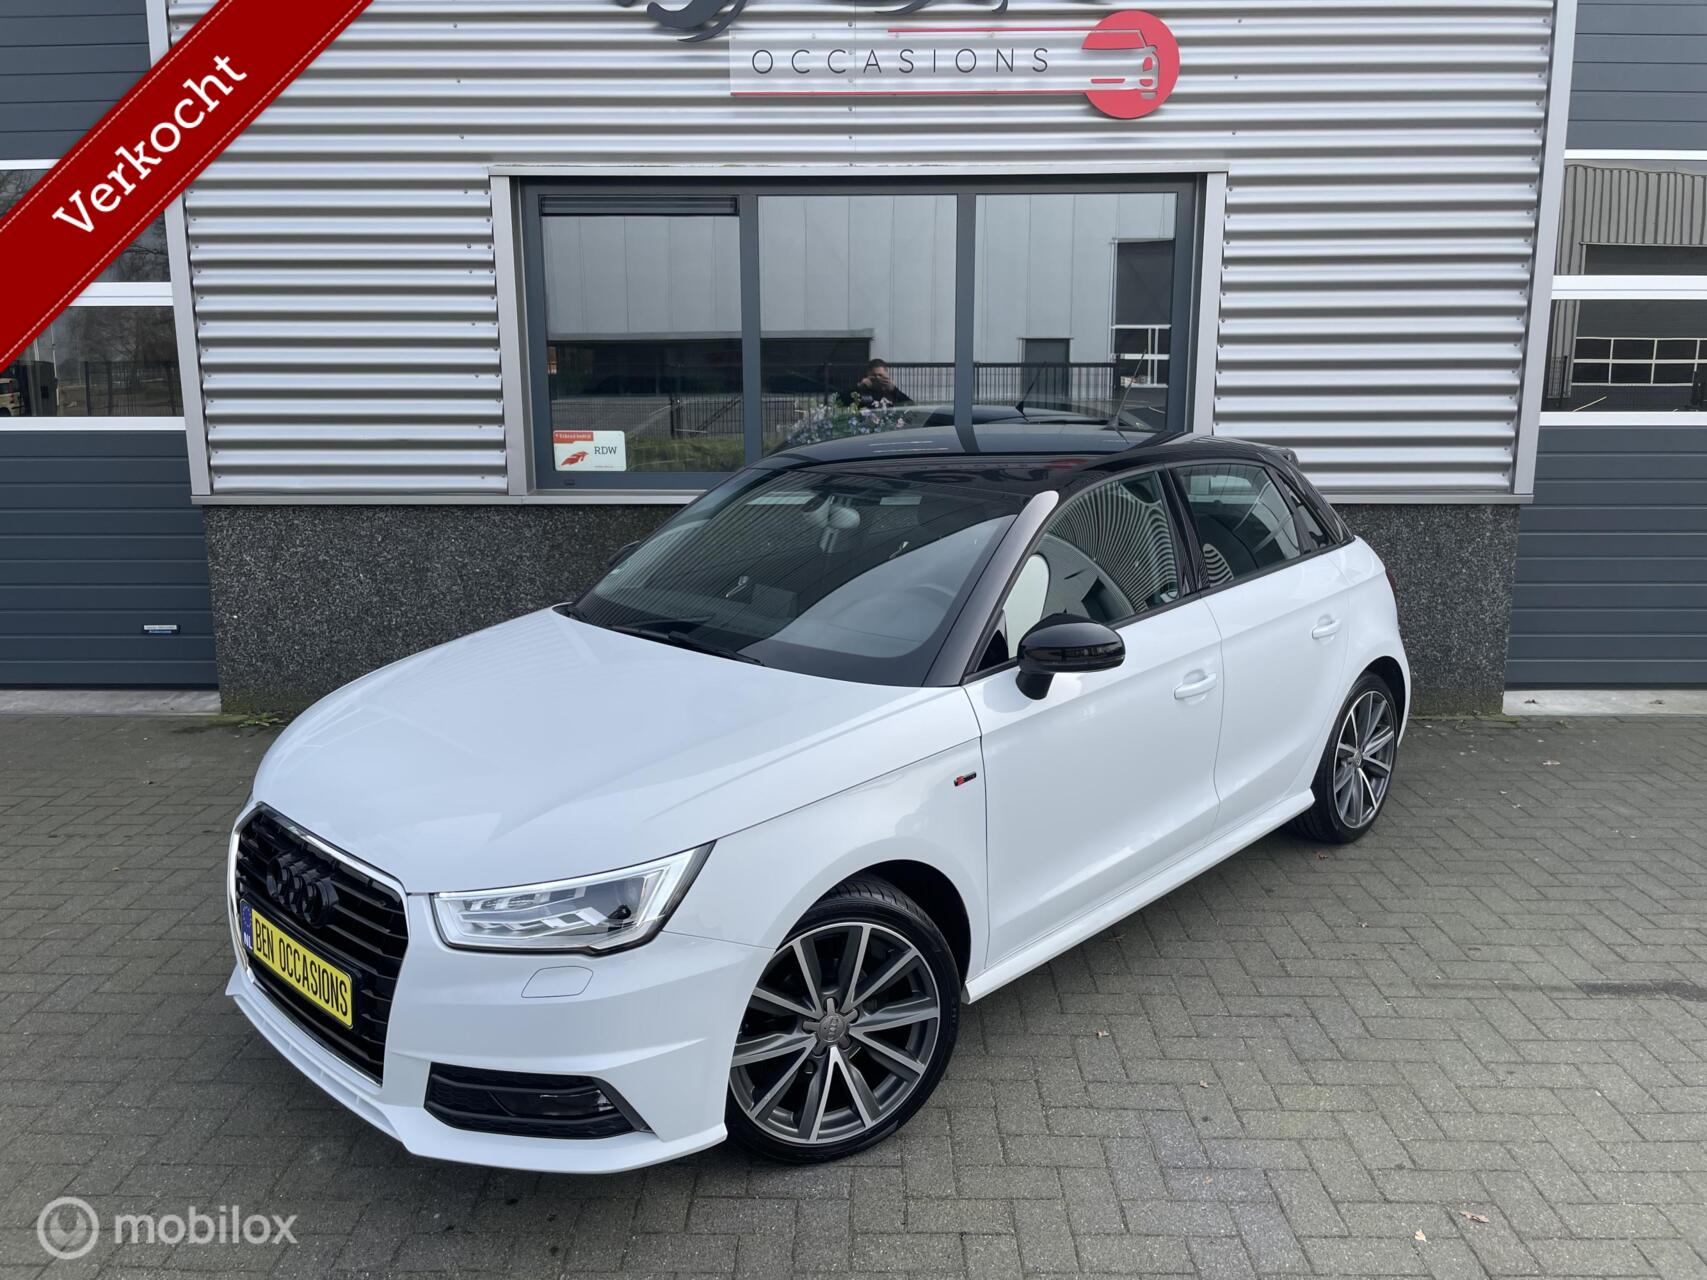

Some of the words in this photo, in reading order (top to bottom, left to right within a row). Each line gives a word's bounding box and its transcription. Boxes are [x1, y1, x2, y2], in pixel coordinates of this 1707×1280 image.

[752, 48, 1049, 74] OCCASIONS
[594, 446, 617, 455] RDW
[243, 932, 253, 950] NL
[255, 918, 275, 964] BEN
[278, 938, 348, 1017] OCCASIONS
